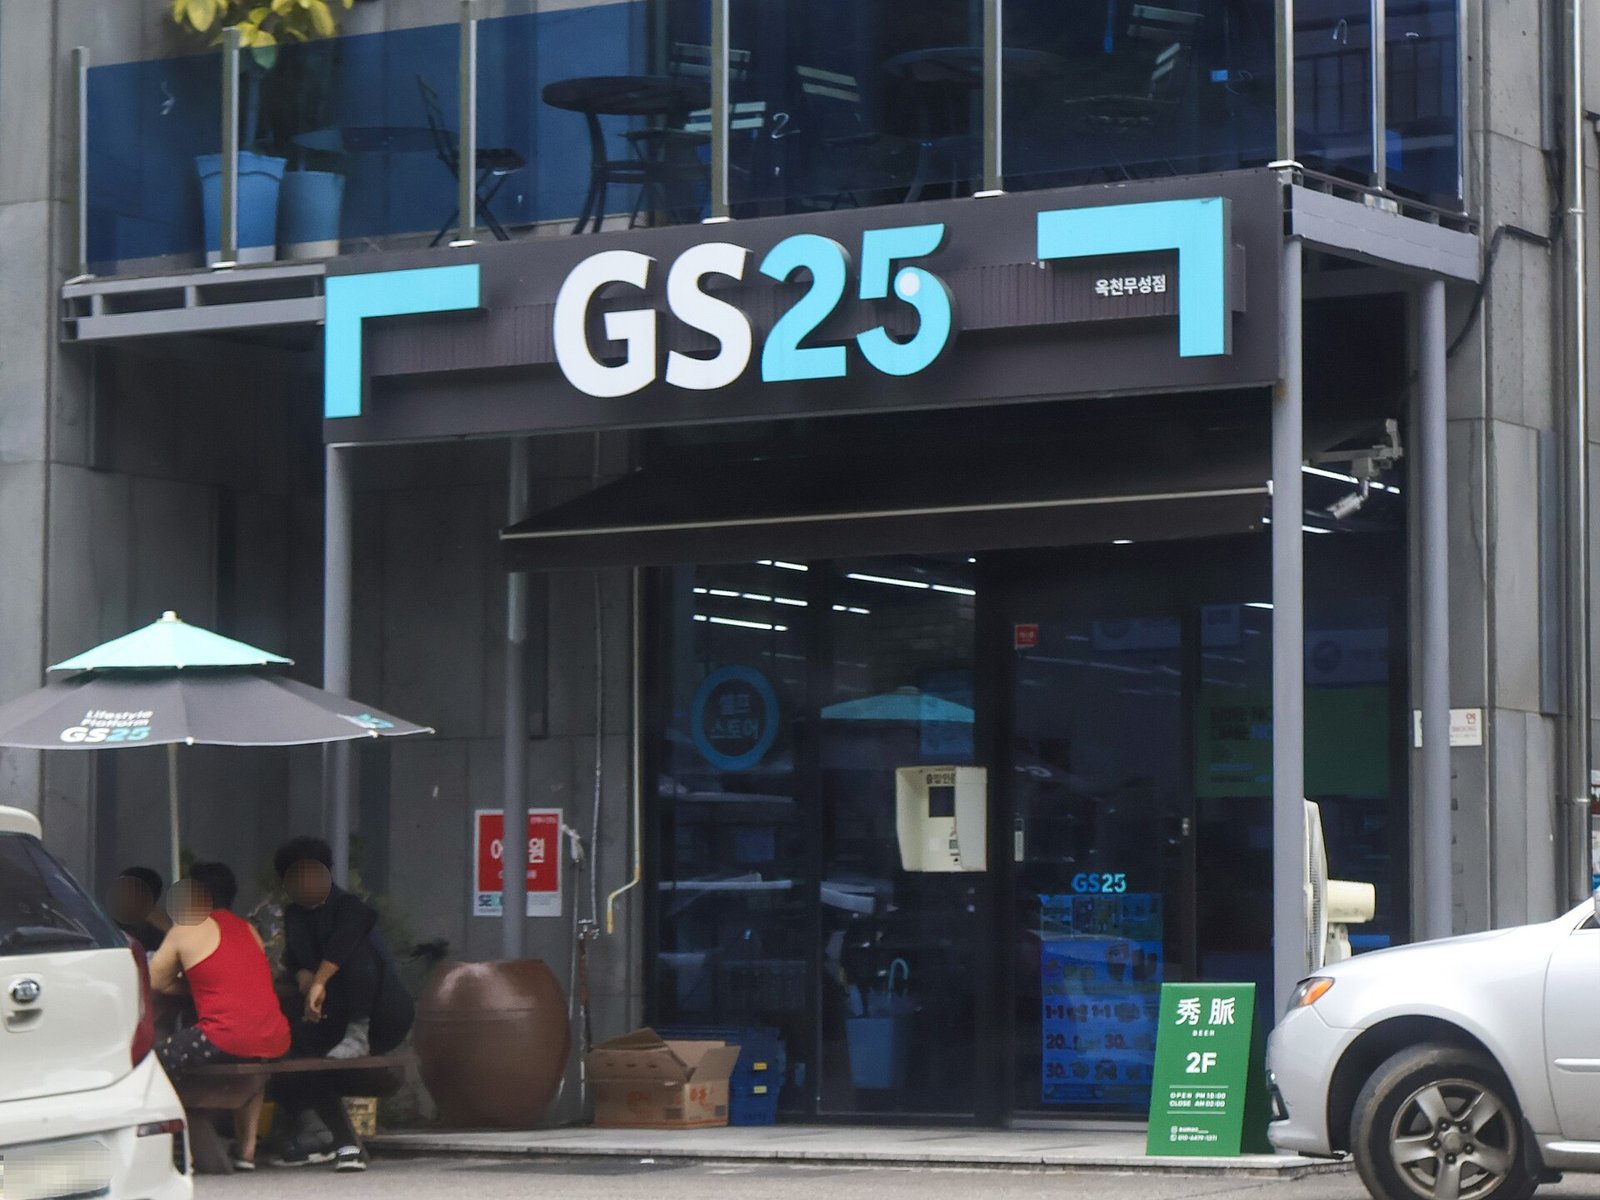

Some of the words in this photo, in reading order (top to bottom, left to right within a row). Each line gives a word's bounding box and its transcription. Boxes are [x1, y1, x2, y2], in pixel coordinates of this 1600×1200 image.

[1094, 273, 1167, 297] 옥천무성점
[553, 223, 955, 398] GS25
[85, 709, 154, 720] Lifestyle
[60, 726, 152, 743] GS25
[1071, 872, 1127, 893] GS25
[1192, 1029, 1216, 1037] BEER
[1185, 1051, 1218, 1074] 2F
